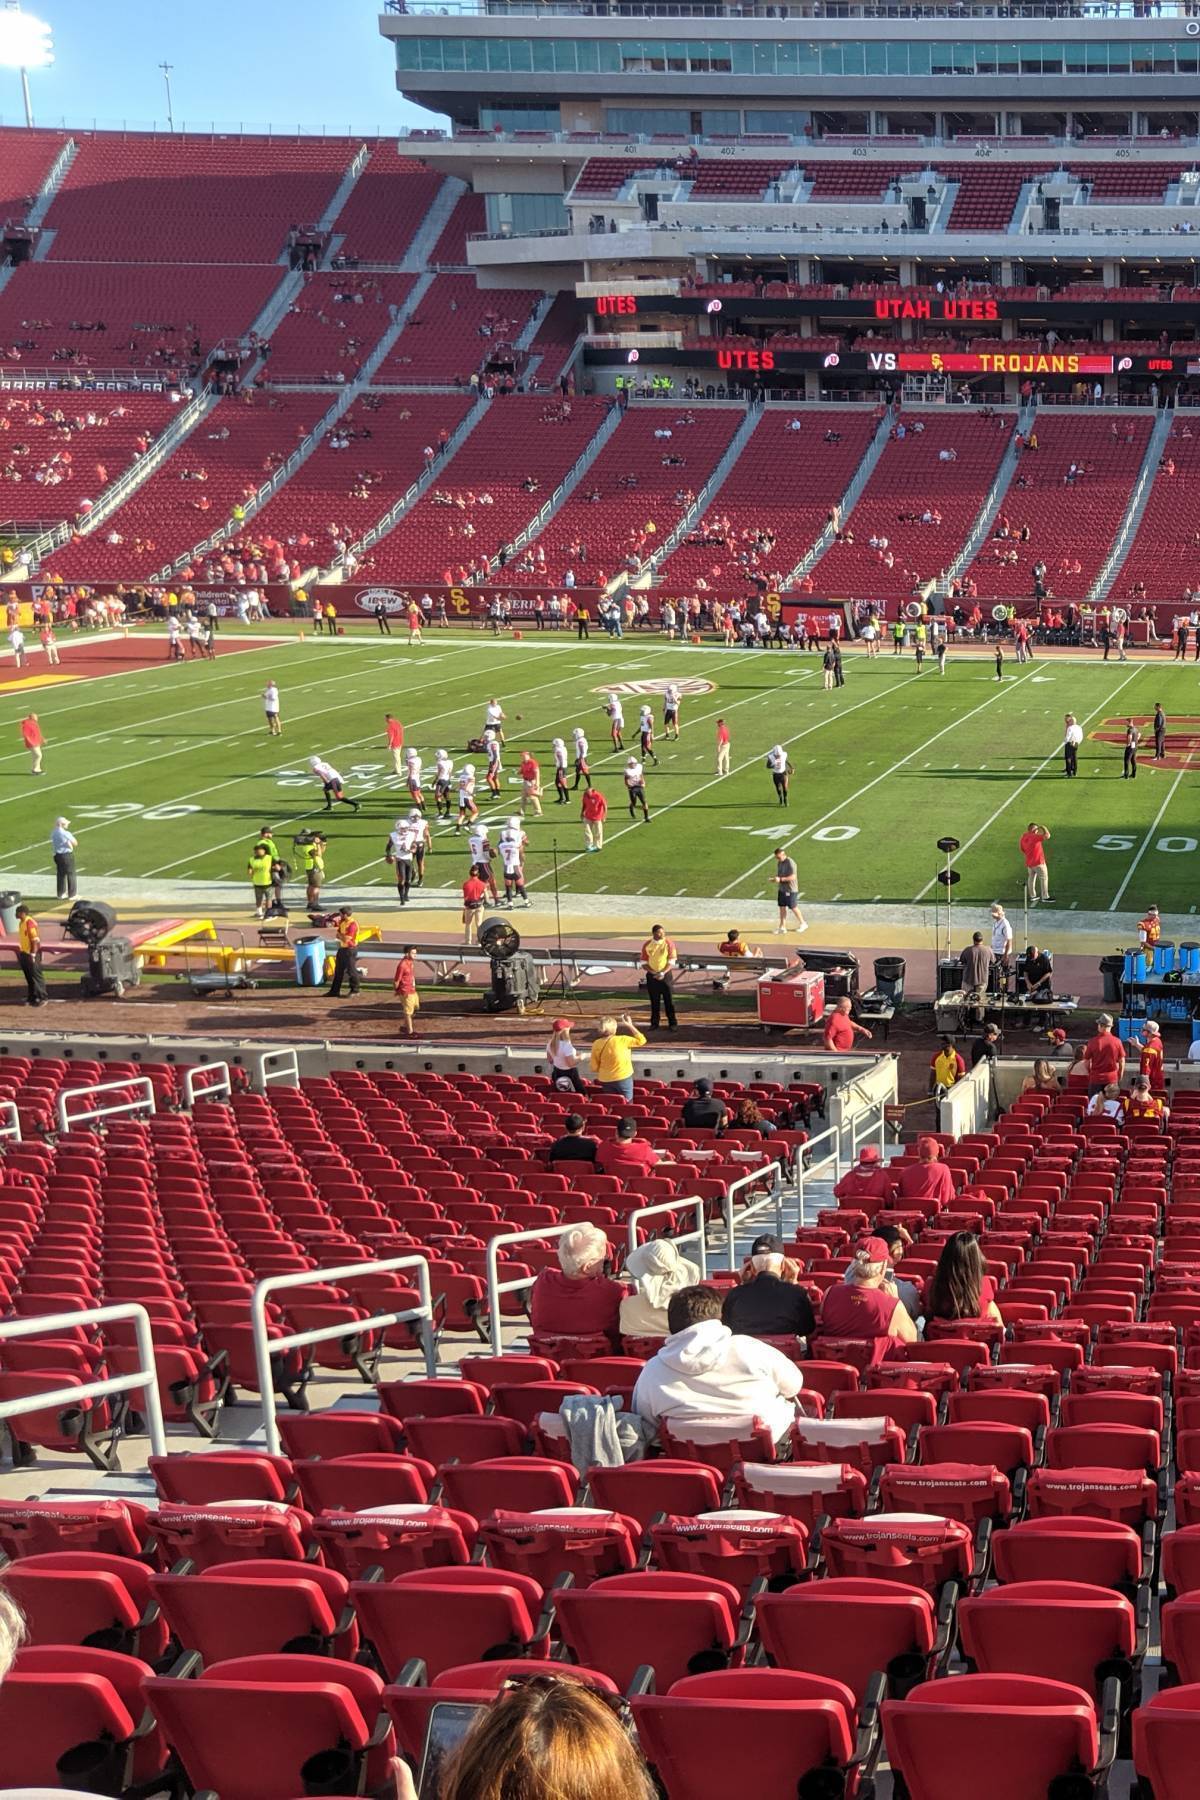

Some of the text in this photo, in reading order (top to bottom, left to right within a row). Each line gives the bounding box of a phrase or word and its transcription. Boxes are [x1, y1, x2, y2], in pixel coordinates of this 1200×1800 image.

[720, 146, 736, 156] 402
[852, 148, 868, 157] 403
[974, 149, 990, 158] 404
[1115, 149, 1130, 158] 405
[596, 296, 637, 315] UTES
[875, 299, 998, 319] UTAH UTES
[718, 350, 774, 370] UTES
[871, 353, 896, 371] VS
[979, 354, 1080, 373] TROJANS
[1148, 359, 1173, 370] UTES
[75, 802, 203, 820] 20
[749, 824, 861, 841] 40
[1093, 834, 1199, 853] 50
[896, 1478, 988, 1489] www.trojanseats.com
[1046, 1482, 1137, 1493] www.trojanseats.com
[330, 1516, 428, 1529] www.trojanseats.com
[675, 1521, 774, 1535] www.trojanseats.com
